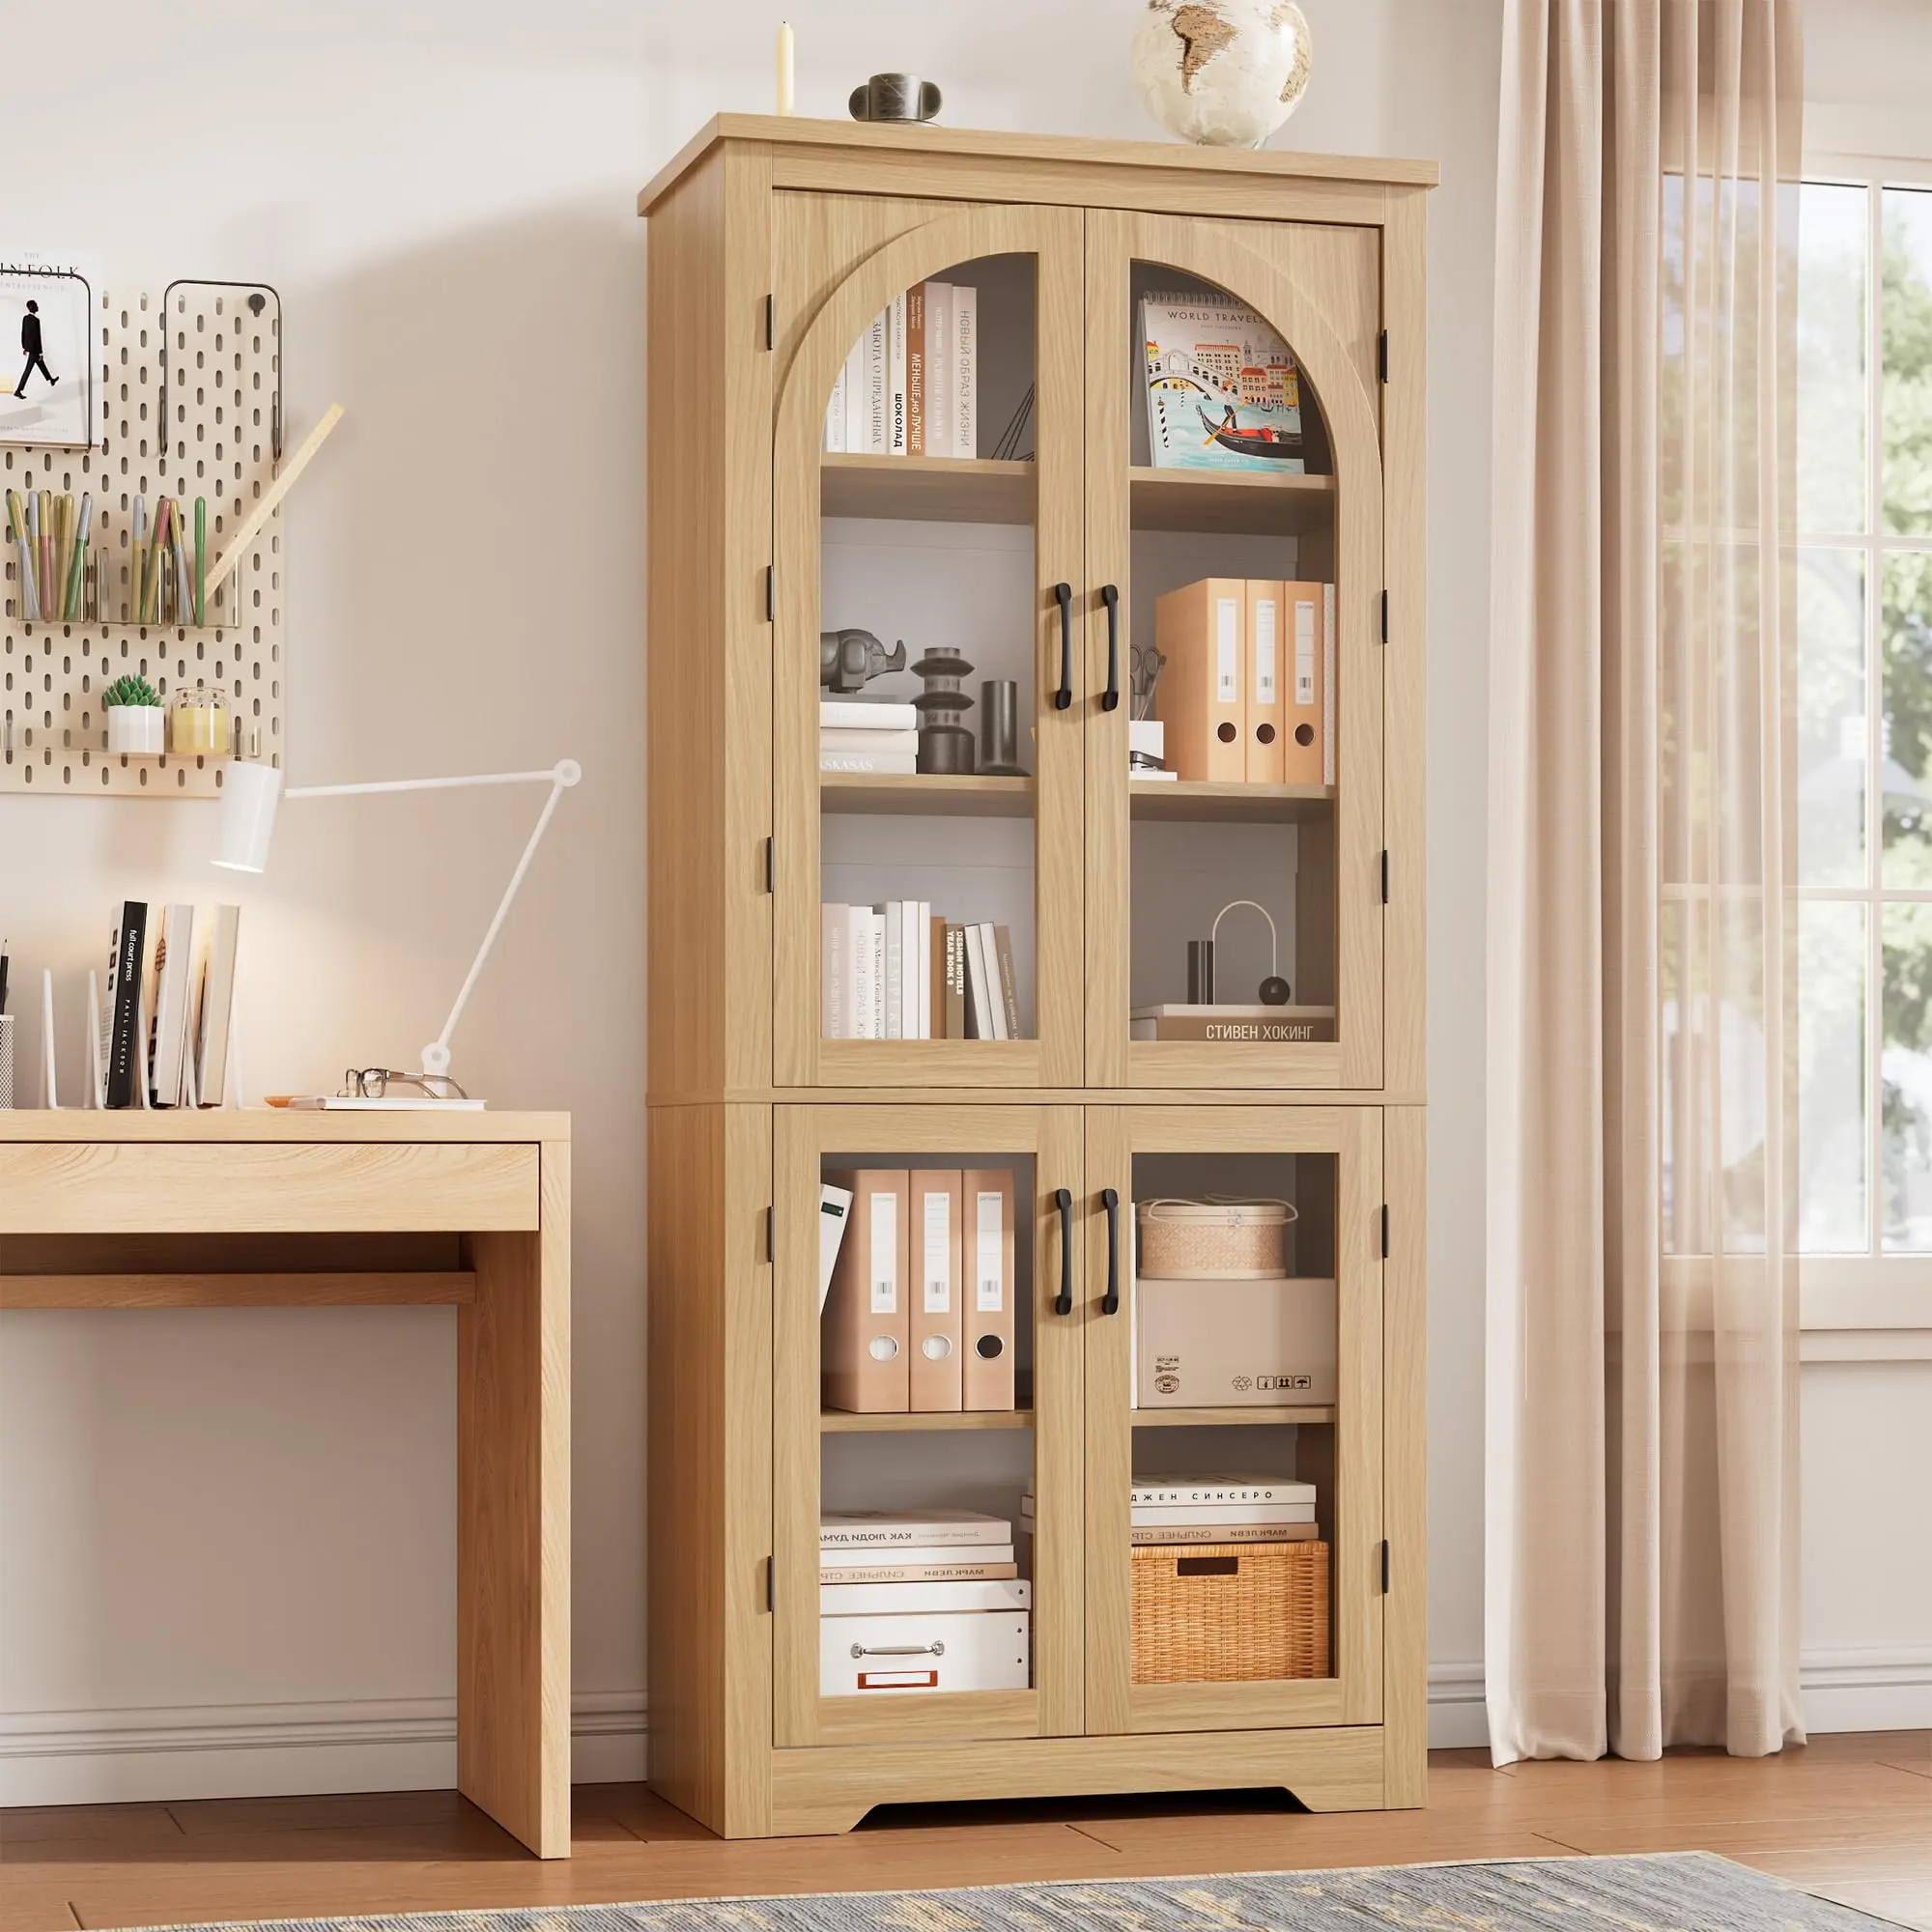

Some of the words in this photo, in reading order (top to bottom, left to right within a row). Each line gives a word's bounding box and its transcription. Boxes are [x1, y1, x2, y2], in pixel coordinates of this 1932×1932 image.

[959, 310, 971, 355] НОВЫЙ
[1167, 310, 1210, 322] WORLD
[872, 321, 883, 361] ЗАБОТА
[872, 364, 882, 374] О
[959, 358, 970, 397] ОБРАЗ
[871, 376, 882, 444] ПРЕДАННЫХ
[894, 393, 903, 447] ШОКОЛАД
[959, 401, 970, 446] ЖИЗНИ
[911, 414, 921, 450] ЛУЧШЕ
[127, 943, 136, 963] court
[125, 962, 134, 981] press
[1206, 1024, 1259, 1039] СТИВЕН
[1262, 1025, 1315, 1040] ХОКИНГ
[1130, 1492, 1178, 1502] ДЖЕН
[1192, 1491, 1272, 1500] СИНСЕРО
